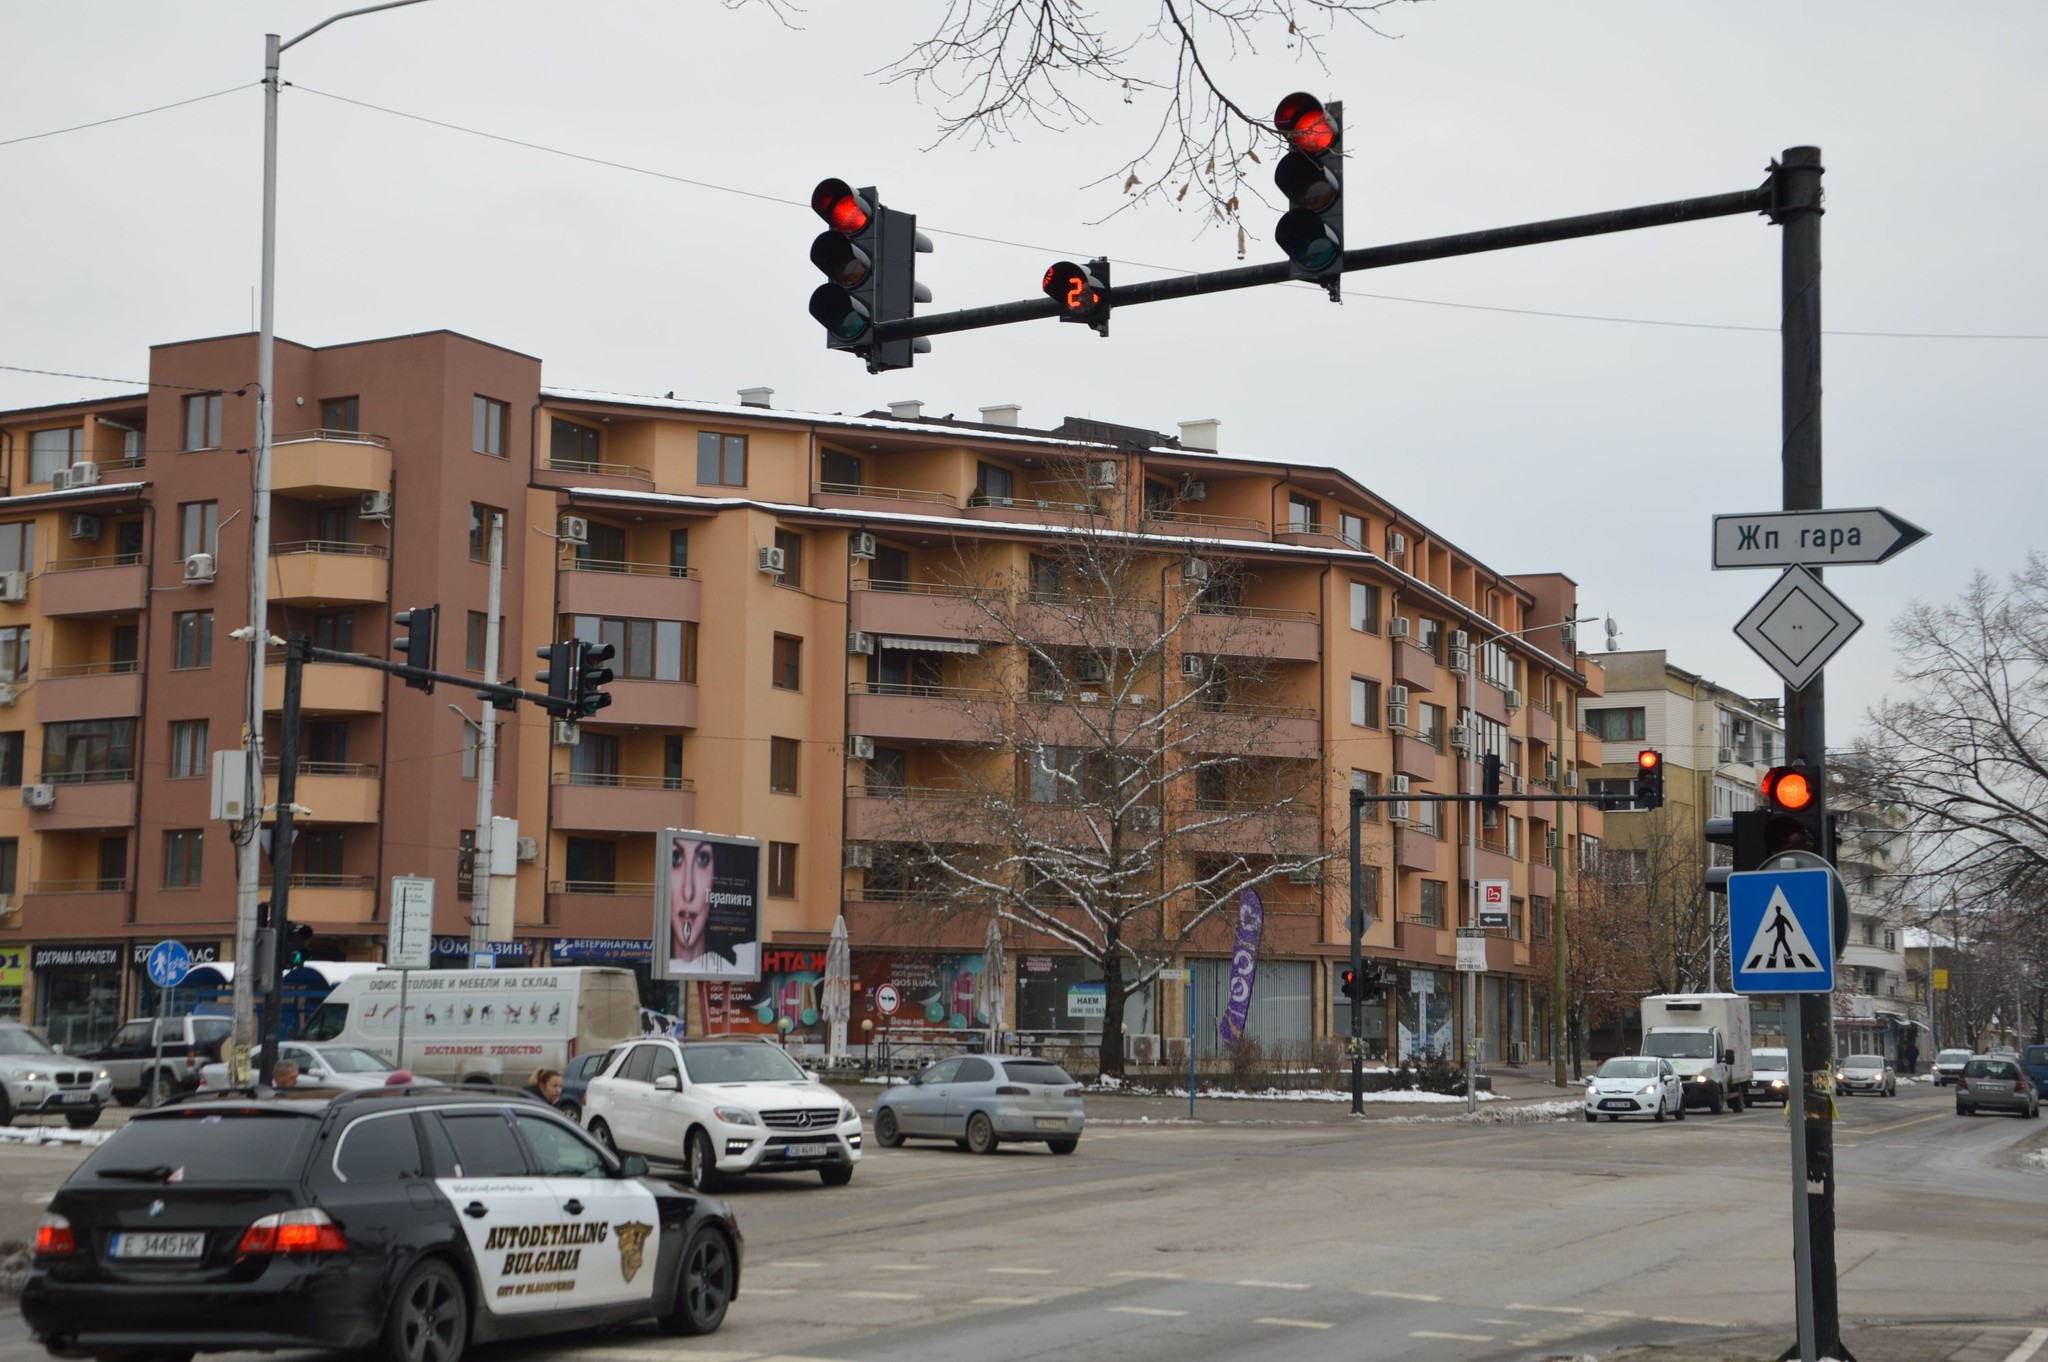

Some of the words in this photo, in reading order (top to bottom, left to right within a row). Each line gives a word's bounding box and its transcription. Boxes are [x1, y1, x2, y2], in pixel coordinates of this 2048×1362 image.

[1737, 525, 1779, 550] Жп
[1800, 527, 1861, 554] гара
[704, 888, 752, 908] Терапията
[574, 939, 641, 950] ВЕТЕРИНАРНА
[35, 951, 73, 967] ДОГРАМА
[75, 950, 117, 965] ПАРАПЕТИ
[369, 980, 397, 991] ОФИС
[404, 978, 444, 990] ТОЛОВЕ
[448, 978, 455, 989] И
[459, 977, 500, 989] МЕБЕЛИ
[504, 977, 518, 988] НА
[521, 976, 558, 989] СКЛАД
[1077, 997, 1099, 1005] НАЕМ
[424, 1045, 484, 1056] ДОСТАВЯМЕ
[490, 1045, 543, 1056] УДОБСТВО
[485, 1221, 609, 1250] AUTODETAILING
[502, 1249, 581, 1276] BULGARIA
